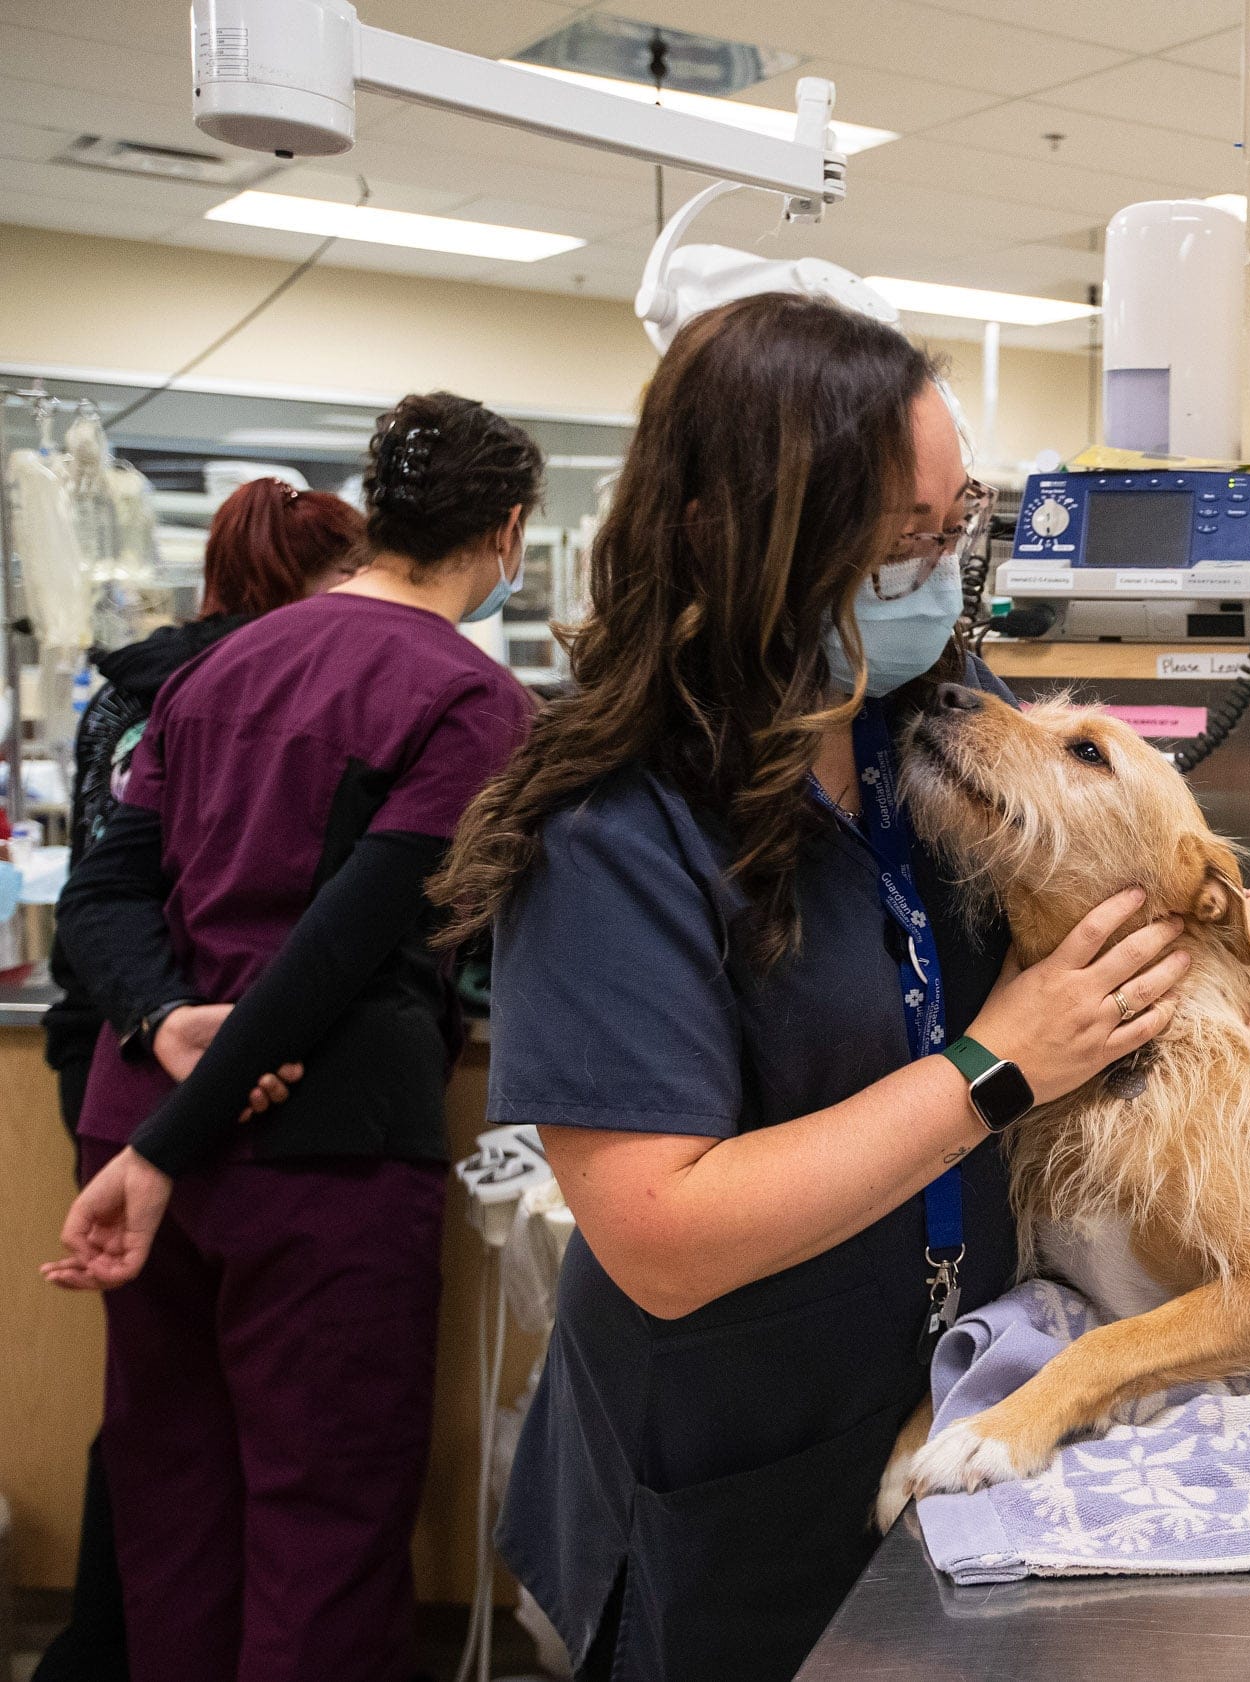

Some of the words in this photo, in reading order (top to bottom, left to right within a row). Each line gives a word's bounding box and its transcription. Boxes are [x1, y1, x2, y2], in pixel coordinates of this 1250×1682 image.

[1162, 657, 1200, 673] Please
[1210, 657, 1242, 673] Leav
[876, 782, 891, 829] Guardian
[881, 872, 912, 915] Guardian
[931, 978, 940, 1027] Guardian
